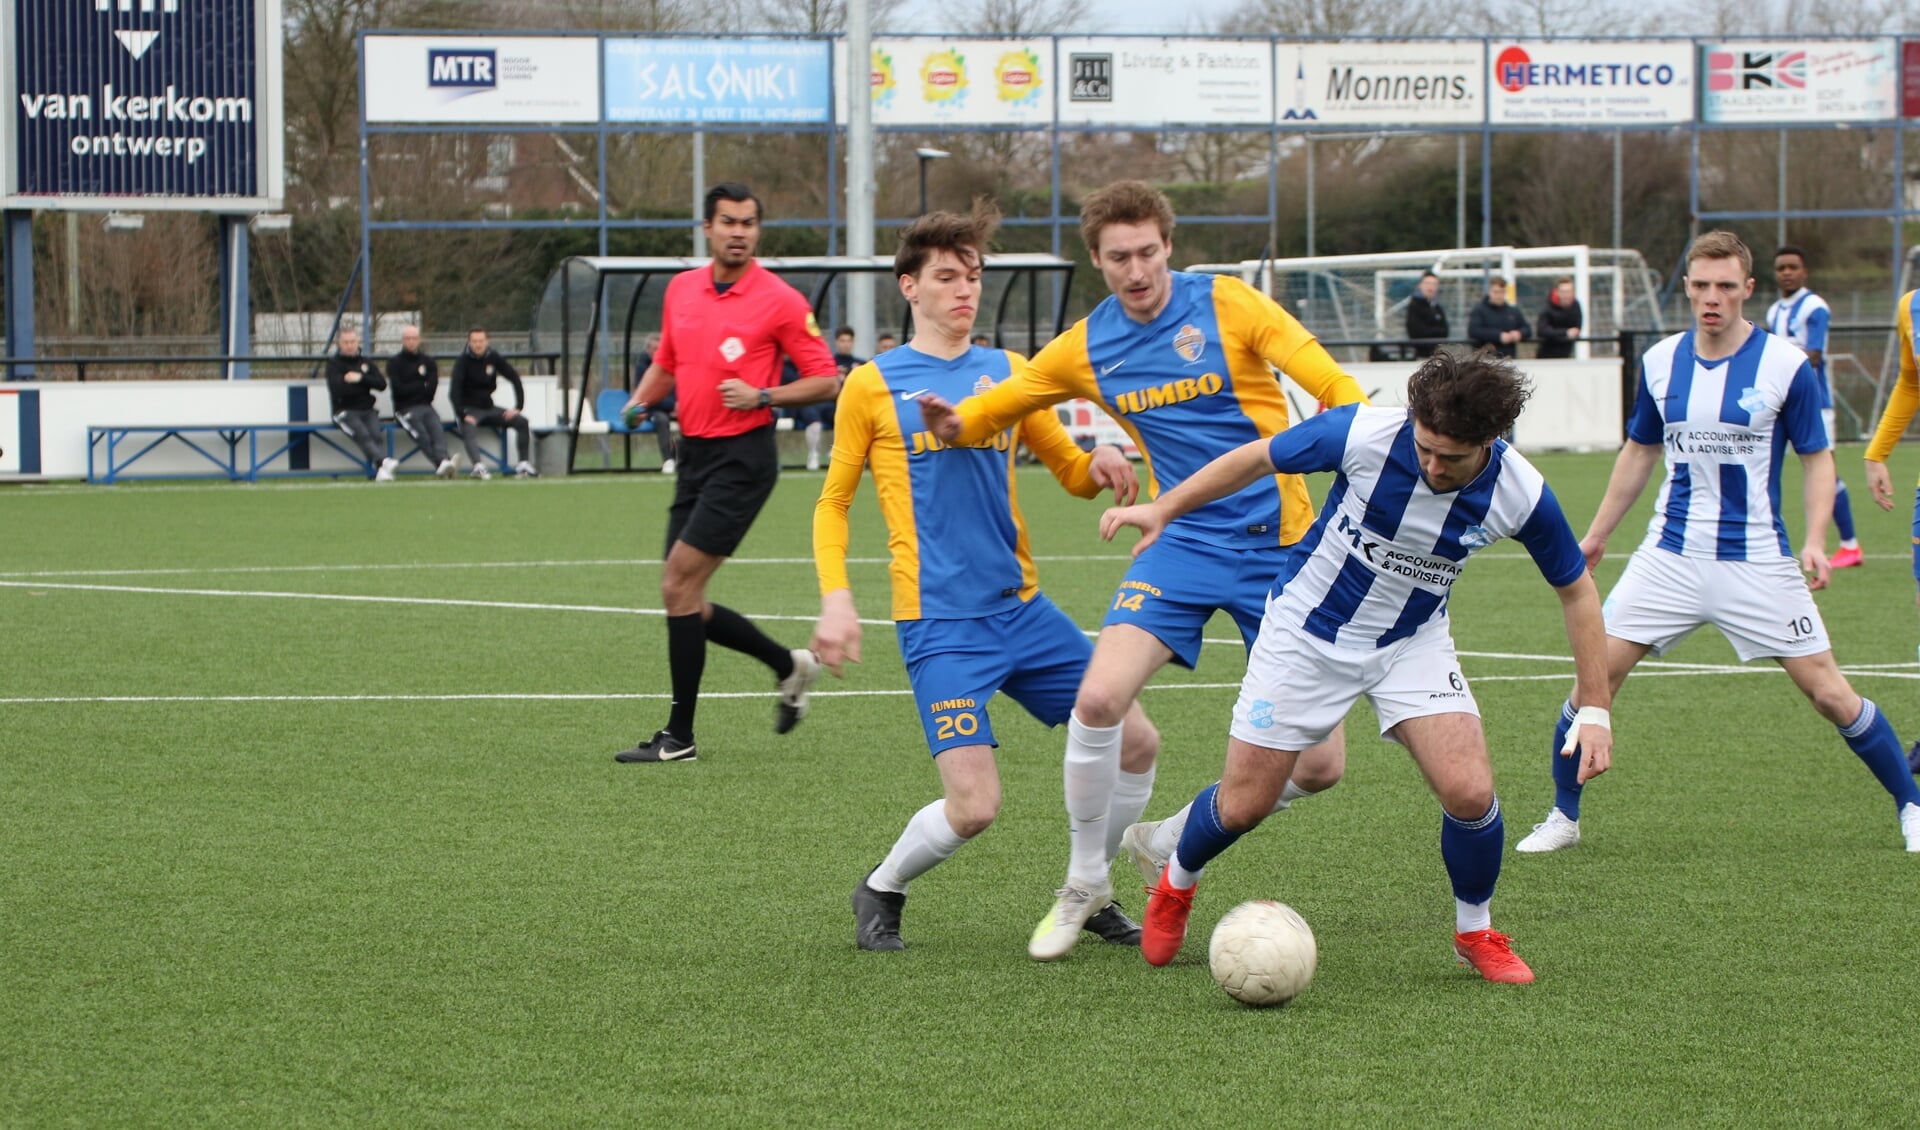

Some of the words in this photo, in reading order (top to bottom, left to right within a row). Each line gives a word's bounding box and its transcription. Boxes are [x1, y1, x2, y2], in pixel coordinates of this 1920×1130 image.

[432, 55, 493, 82] MTR
[1074, 60, 1109, 78] Jill
[1122, 52, 1175, 74] Living
[1196, 52, 1259, 69] Fashion
[1503, 62, 1674, 87] HERMETICO
[639, 59, 798, 103] SALONIKI
[1326, 67, 1475, 101] Monnens.
[21, 93, 91, 120] van
[103, 84, 252, 123] kerkom
[71, 132, 206, 164] ontwerp
[1115, 372, 1224, 416] JUMBO
[911, 430, 1009, 456] JUO
[1688, 431, 1764, 443] ACCOUNTANTS
[1699, 445, 1755, 455] ADVISEURS
[1381, 560, 1391, 570] &
[1113, 592, 1146, 612] 14
[1787, 616, 1813, 637] 10
[1448, 671, 1463, 691] 6
[930, 698, 976, 714] JUMBO
[935, 712, 978, 740] 20
